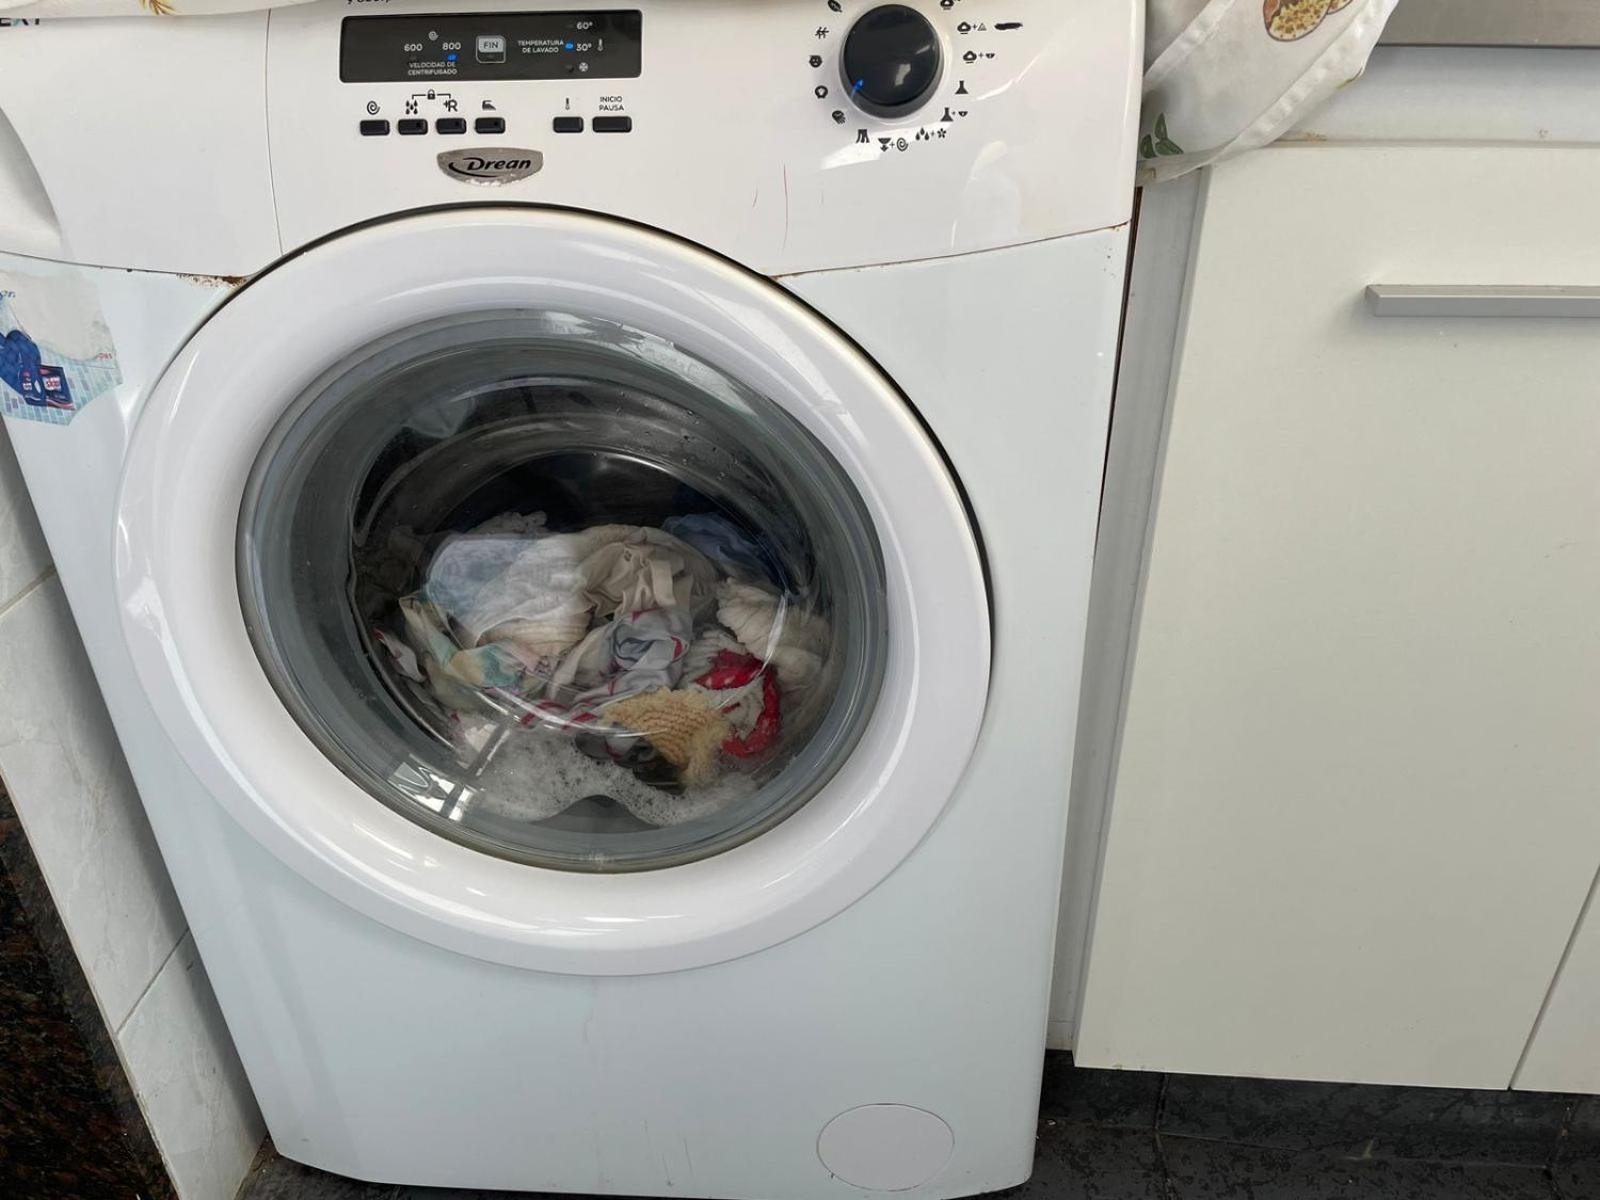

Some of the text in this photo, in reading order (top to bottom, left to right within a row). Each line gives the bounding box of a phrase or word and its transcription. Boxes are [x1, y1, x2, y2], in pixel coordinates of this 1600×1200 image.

[403, 43, 423, 52] 600
[442, 41, 462, 51] 800
[483, 41, 499, 49] FIN
[408, 61, 446, 69] VELOCIDAD
[407, 68, 458, 76] CENTRIFUGADO
[458, 156, 532, 173] Drean
